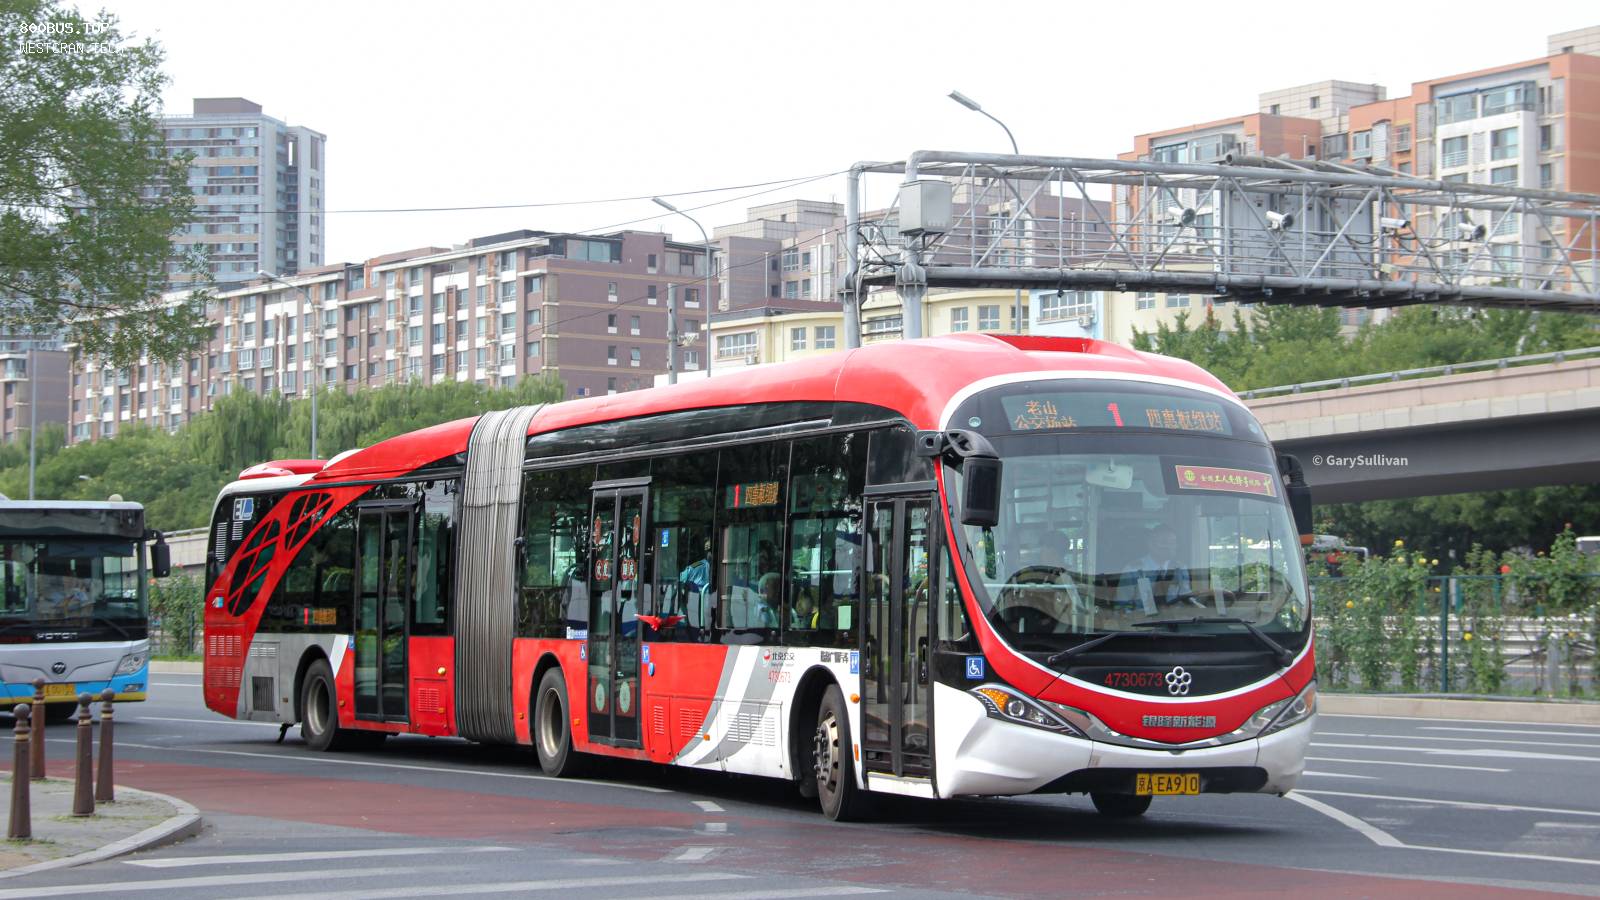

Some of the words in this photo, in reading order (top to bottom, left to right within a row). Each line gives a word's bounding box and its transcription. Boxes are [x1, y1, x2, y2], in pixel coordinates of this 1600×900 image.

[1024, 400, 1057, 415] 老山
[1107, 402, 1124, 427] 1
[734, 483, 740, 508] 1
[1104, 672, 1163, 687] 4730673
